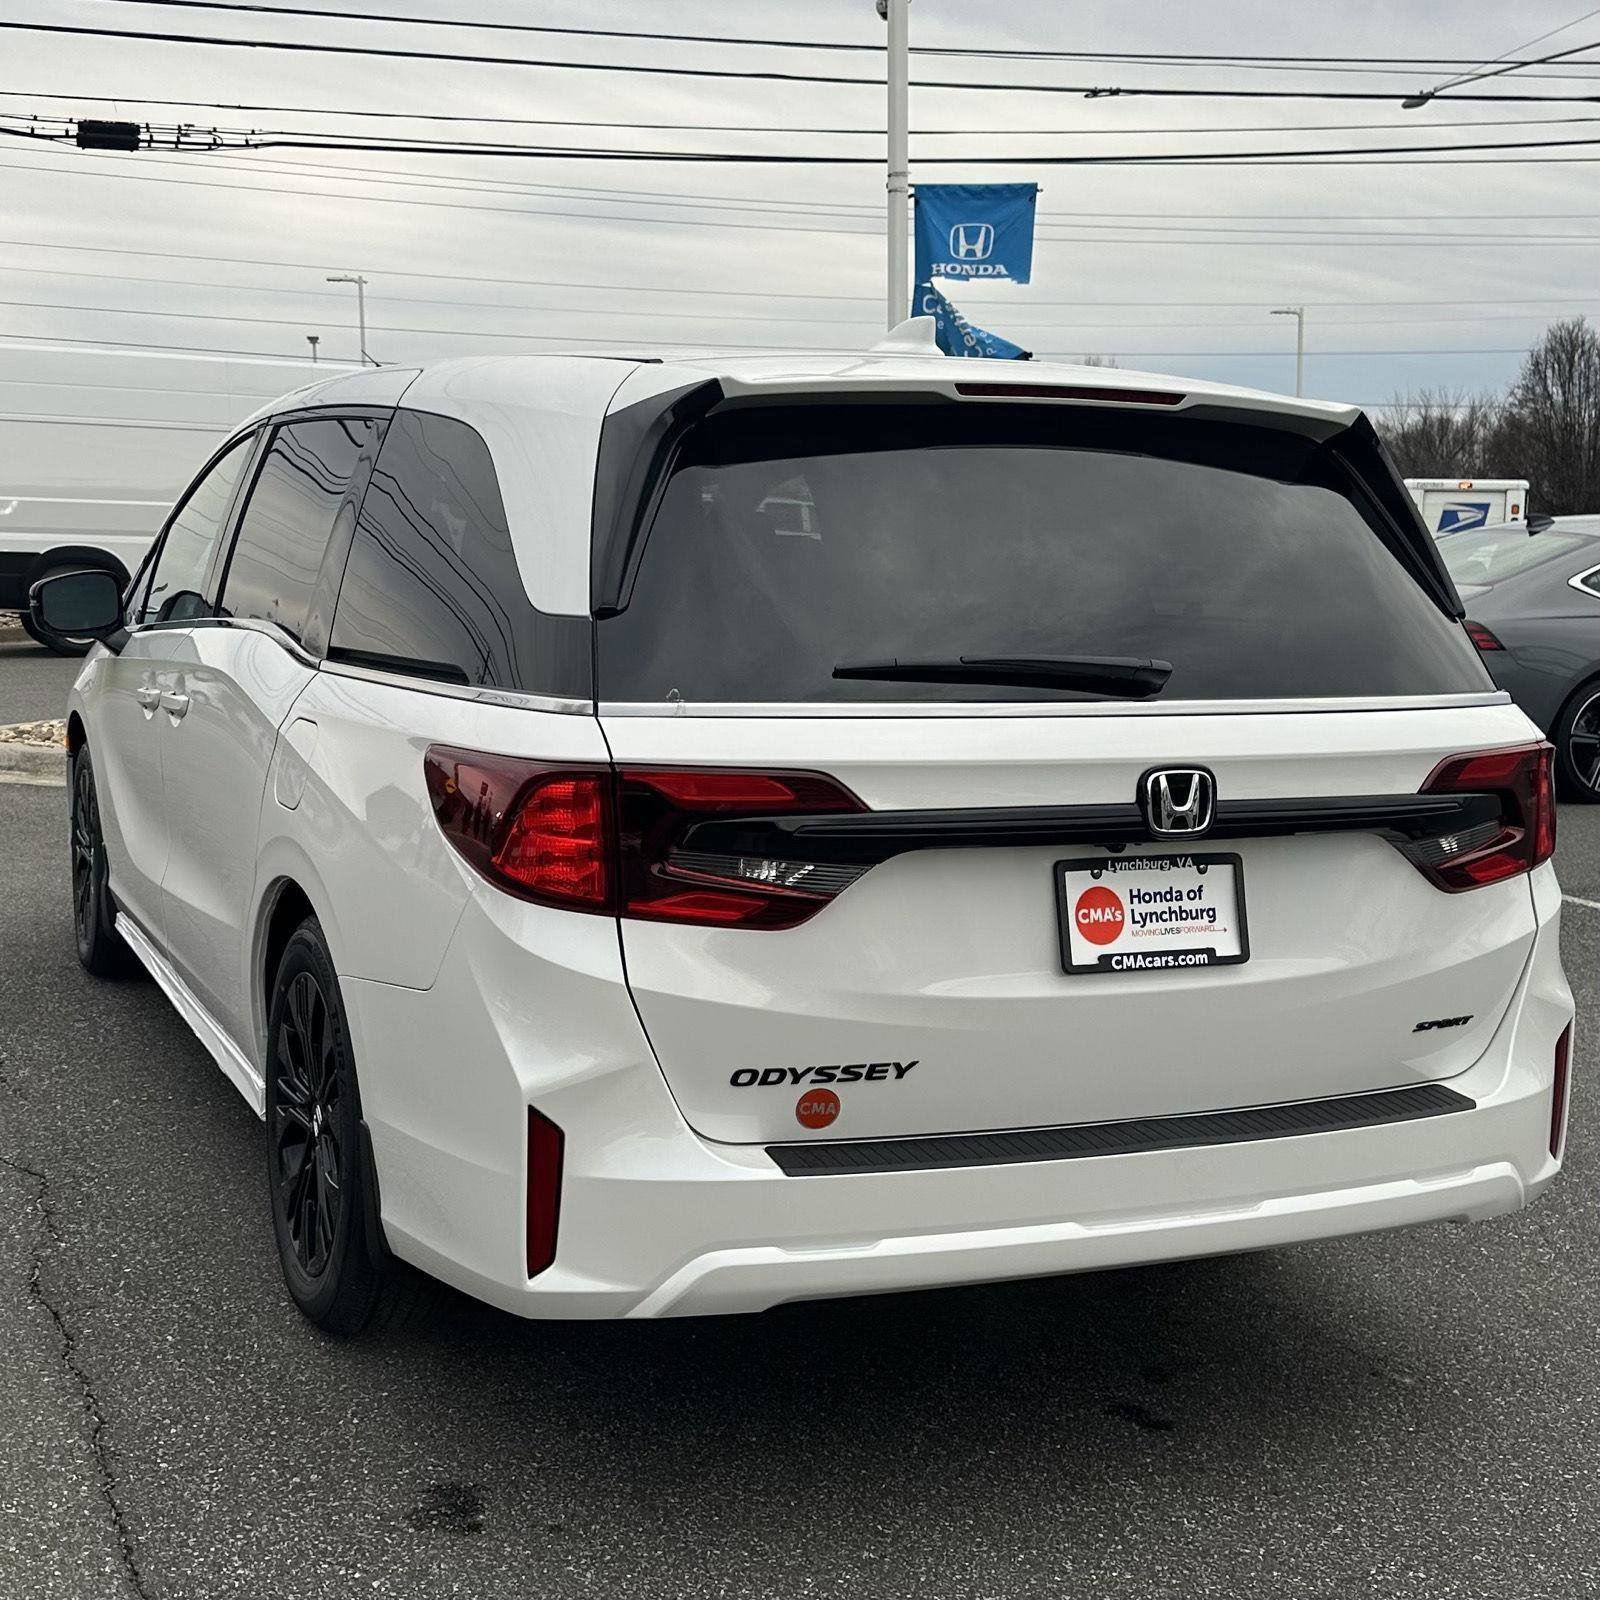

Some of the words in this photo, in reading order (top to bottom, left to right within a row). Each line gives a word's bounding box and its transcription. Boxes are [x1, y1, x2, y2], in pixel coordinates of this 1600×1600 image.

[931, 263, 1008, 275] HONDA
[1177, 857, 1194, 868] VA
[1129, 886, 1184, 905] Honda
[1187, 885, 1204, 901] of
[1078, 908, 1123, 924] CMA's
[1131, 906, 1217, 928] Lynchburg
[1111, 953, 1209, 970] CMAcars.com
[1412, 1015, 1474, 1032] SPORT
[730, 1060, 920, 1087] ODYSSEY
[800, 1102, 836, 1115] CMA
